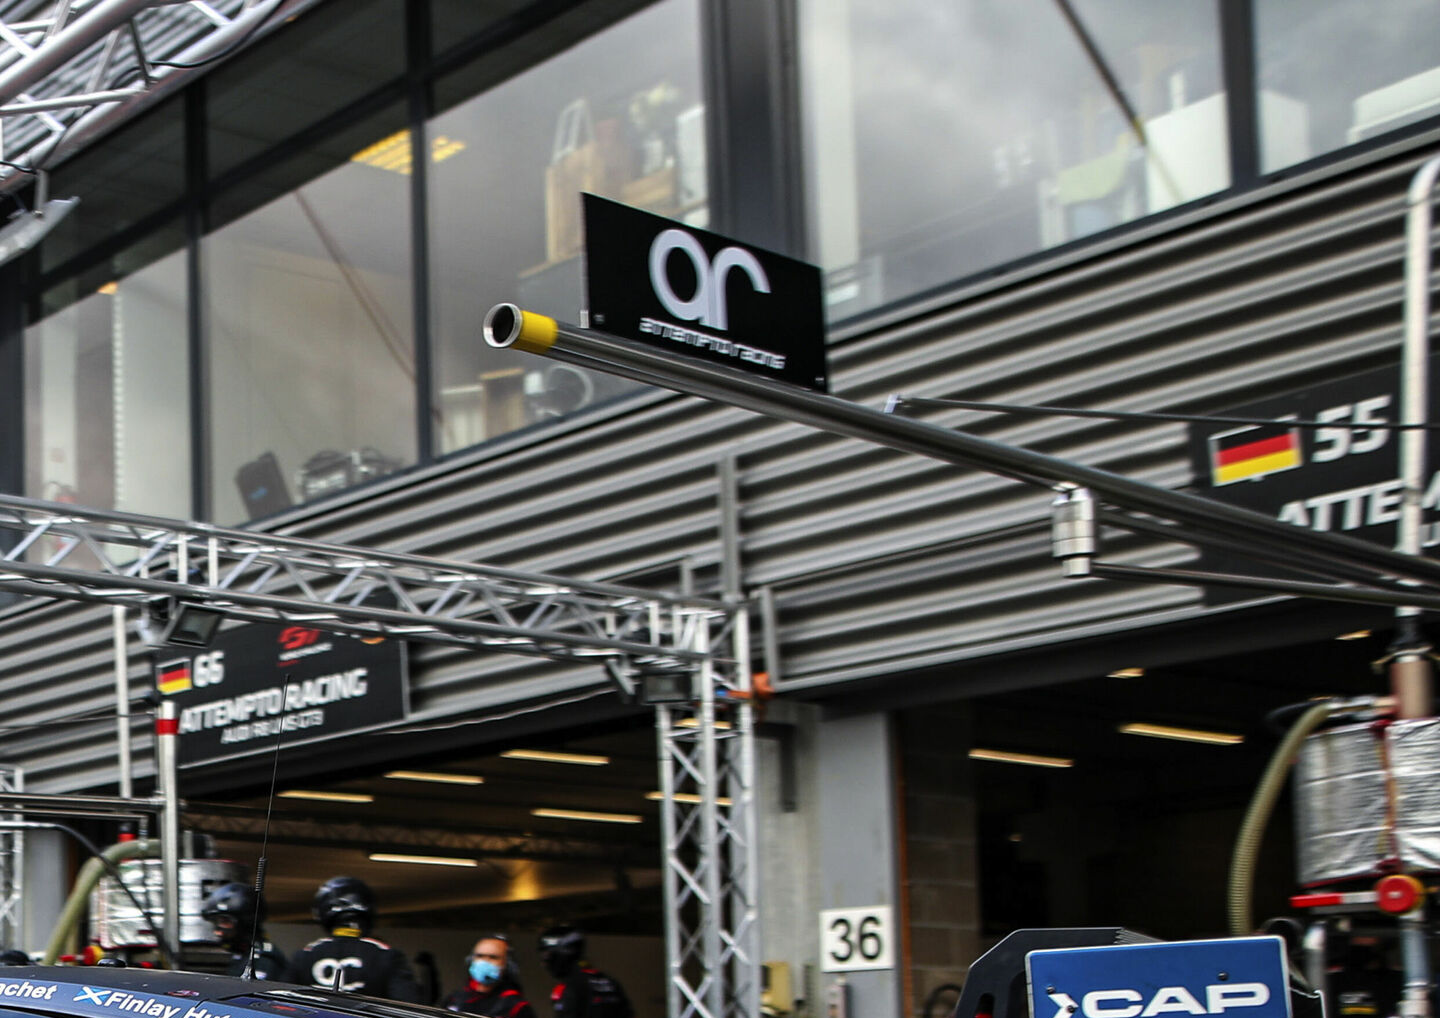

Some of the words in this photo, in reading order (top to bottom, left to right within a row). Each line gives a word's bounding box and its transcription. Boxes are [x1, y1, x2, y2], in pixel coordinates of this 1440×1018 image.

[1312, 394, 1392, 463] 55
[178, 686, 283, 735] ATTEMPTO
[284, 667, 369, 712] RACING
[829, 916, 883, 963] 36
